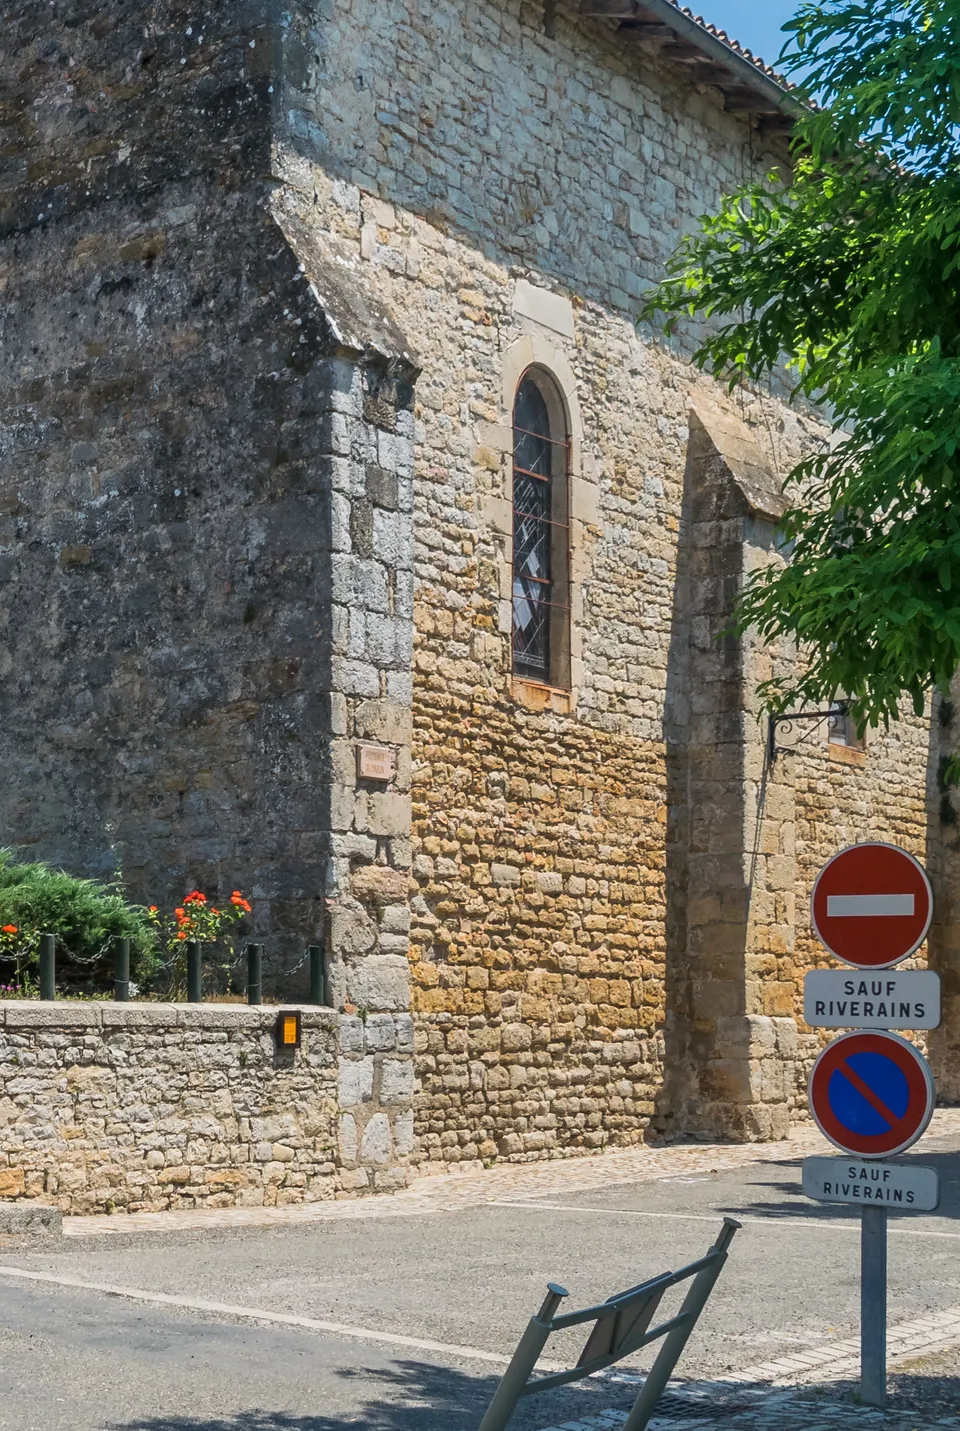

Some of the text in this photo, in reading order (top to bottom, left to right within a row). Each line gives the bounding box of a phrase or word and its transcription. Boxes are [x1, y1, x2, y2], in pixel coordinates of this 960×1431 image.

[844, 981, 896, 997] SAUF
[815, 1001, 926, 1018] RIVERAINS
[848, 1166, 891, 1182] SAUF
[823, 1181, 915, 1204] RIVERAINS
